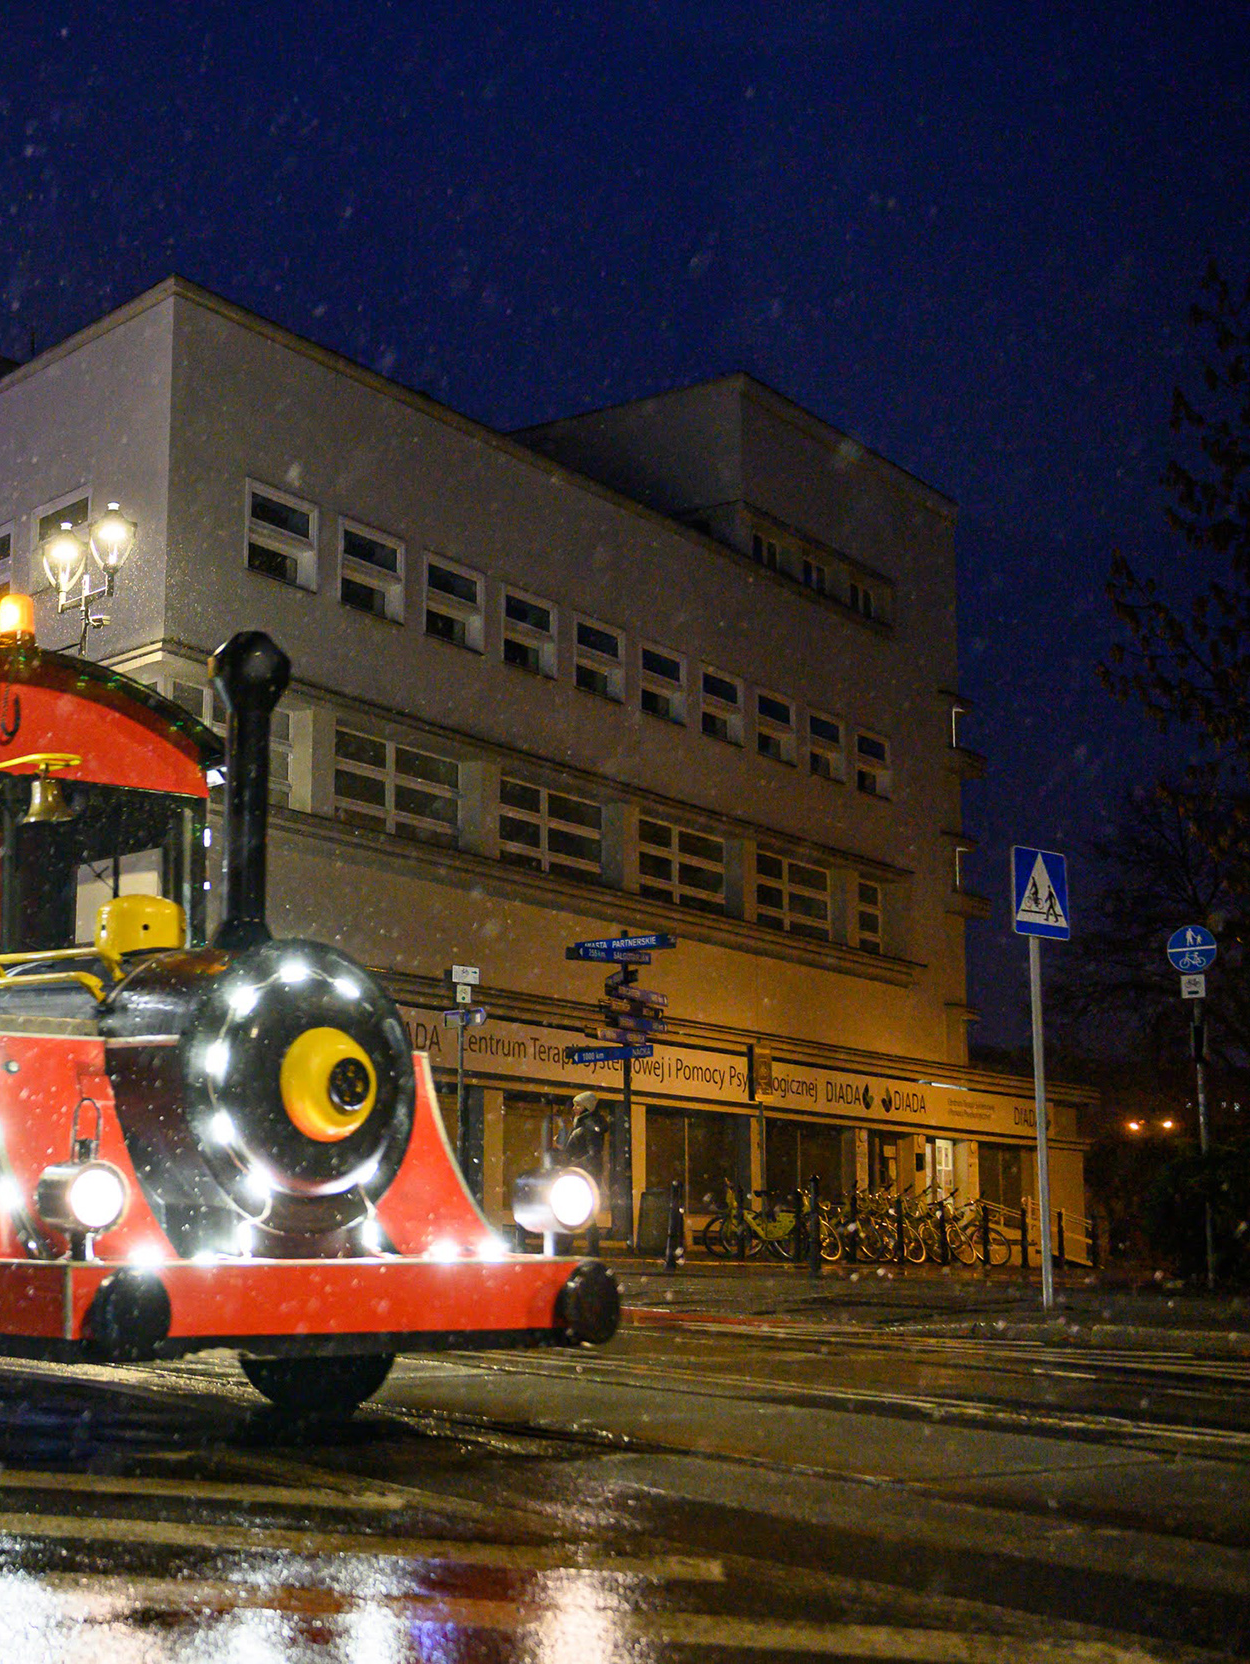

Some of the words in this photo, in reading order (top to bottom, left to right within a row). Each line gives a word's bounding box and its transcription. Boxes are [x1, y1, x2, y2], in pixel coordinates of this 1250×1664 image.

[611, 936, 656, 949] PARTNERSKIE
[405, 1020, 442, 1052] ADA
[456, 1026, 527, 1058] Centrum
[530, 1037, 580, 1070] Terap
[583, 1045, 664, 1083] ysteowej
[667, 1057, 672, 1078] i
[675, 1058, 726, 1090] Pomocy
[729, 1065, 818, 1102] Psyogicznej
[826, 1080, 860, 1105] DIADA
[582, 1052, 595, 1061] 1000
[595, 1051, 605, 1060] km
[893, 1090, 927, 1114] DIADA
[1014, 1106, 1037, 1127] DIAD
